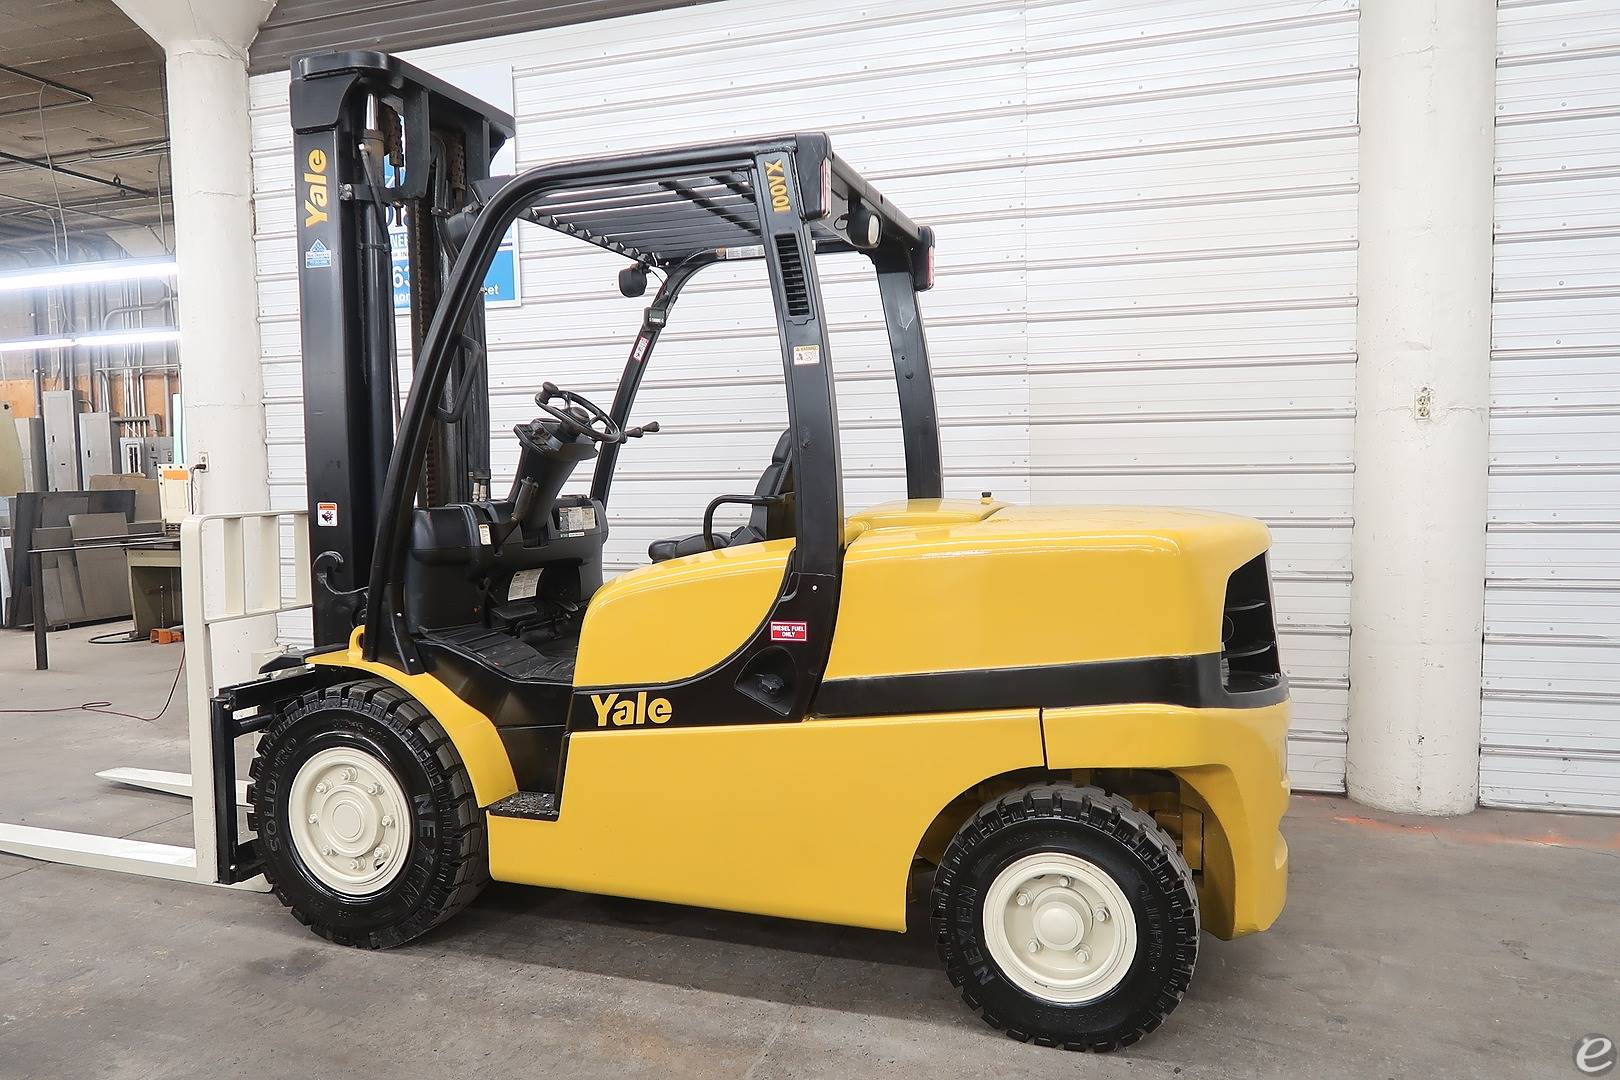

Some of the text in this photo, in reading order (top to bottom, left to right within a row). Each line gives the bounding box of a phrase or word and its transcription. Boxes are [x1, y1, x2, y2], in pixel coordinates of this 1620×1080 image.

[303, 148, 328, 228] Yale
[764, 159, 792, 212] 100VX
[590, 691, 673, 727] Yale
